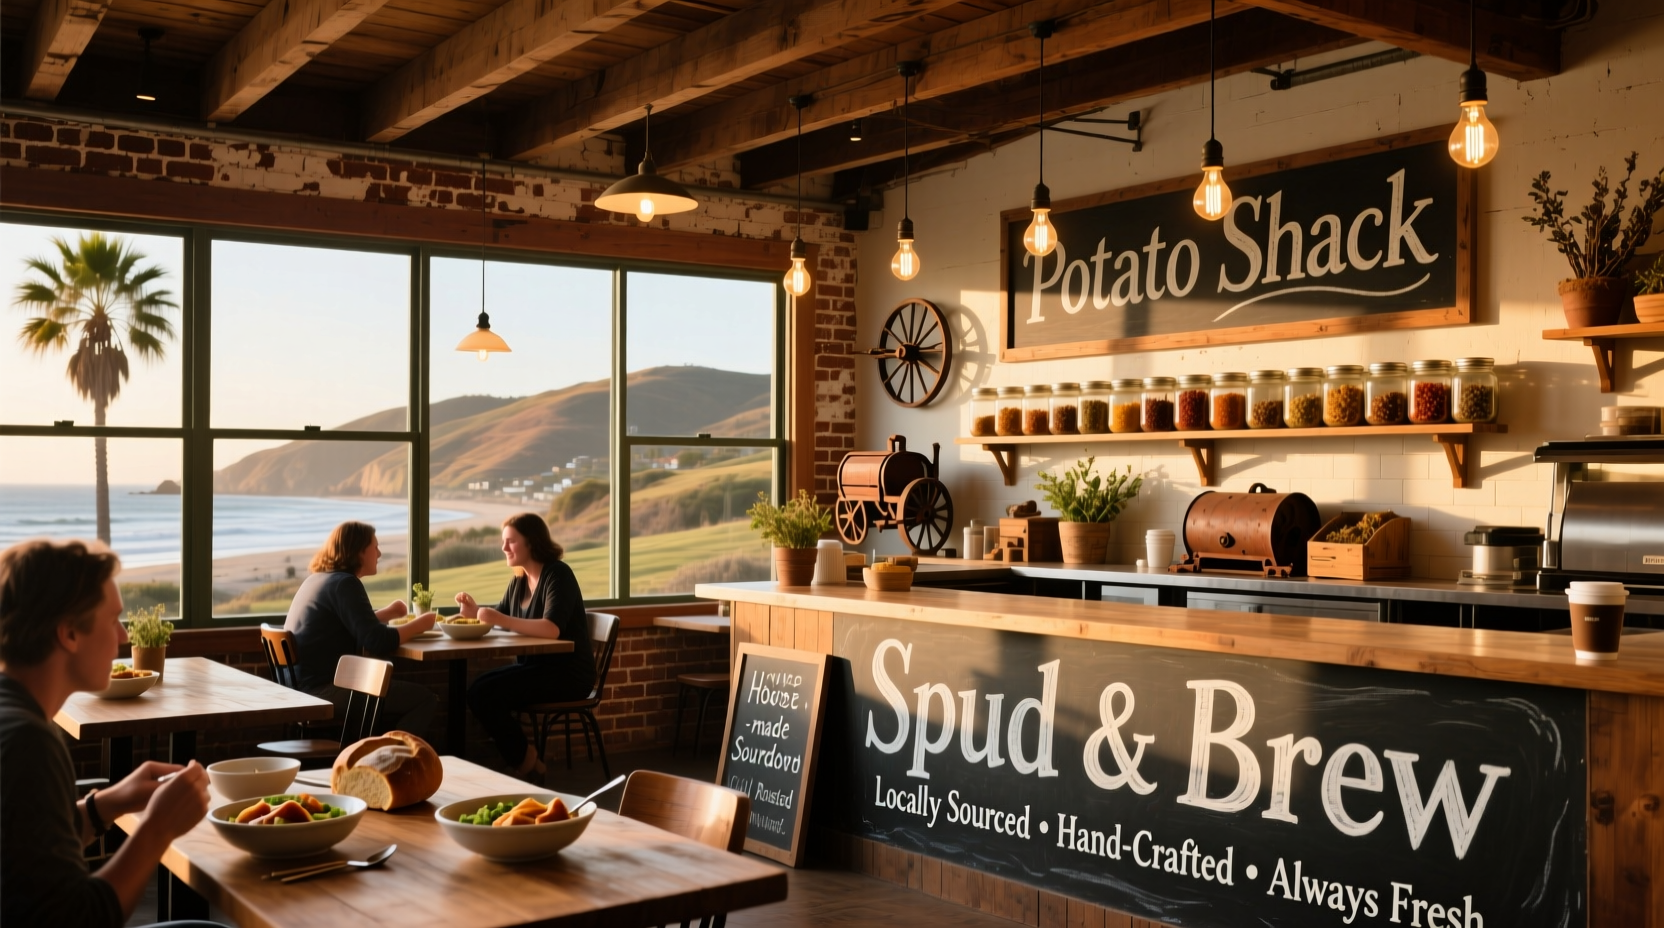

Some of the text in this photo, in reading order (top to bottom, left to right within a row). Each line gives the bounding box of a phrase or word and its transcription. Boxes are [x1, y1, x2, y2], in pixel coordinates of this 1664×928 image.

[1023, 168, 1439, 324] Potato Shack
[866, 638, 1511, 860] Spud & Brew
[875, 776, 942, 828] Locally
[947, 789, 1031, 839] Sourced
[1057, 813, 1234, 886] Hand-Crafted
[1267, 857, 1379, 924] Always
[1390, 881, 1483, 928] Fresh
